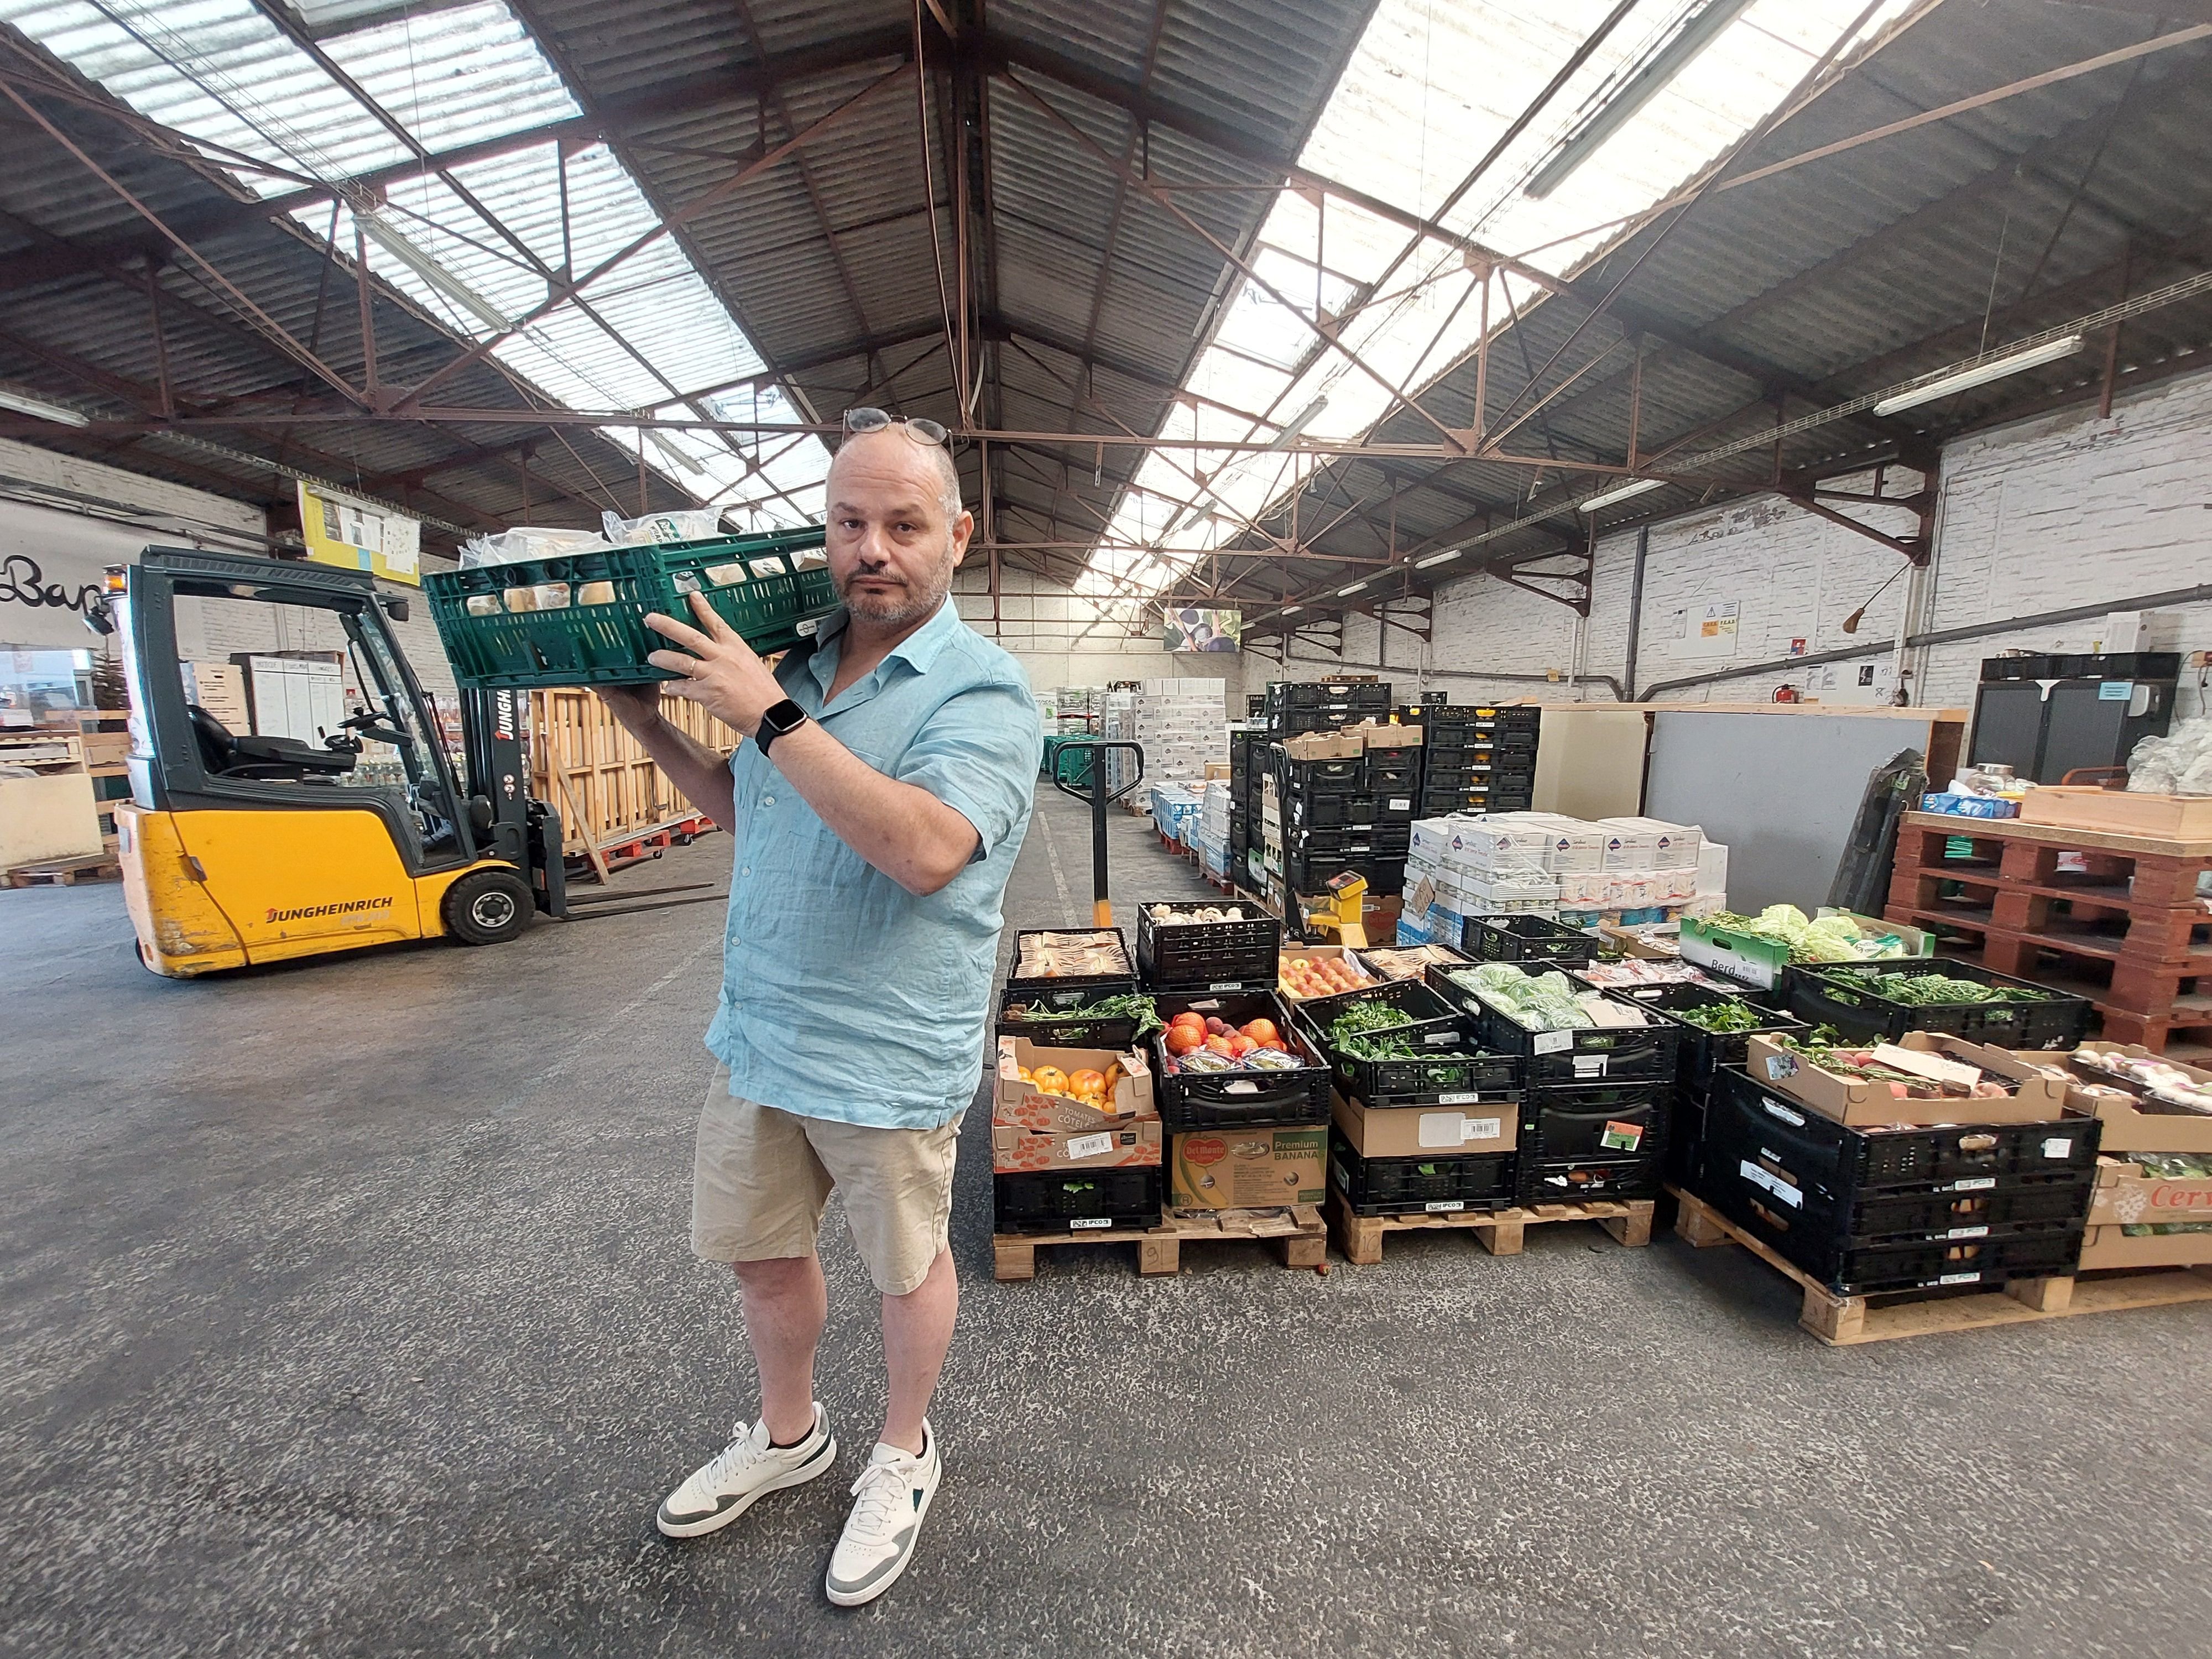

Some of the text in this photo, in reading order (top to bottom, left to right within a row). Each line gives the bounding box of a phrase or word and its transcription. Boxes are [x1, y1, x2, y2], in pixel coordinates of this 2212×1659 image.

[266, 896, 393, 924] JUNGHEINRICH
[1065, 1107, 1096, 1124] TOMATES
[1275, 1141, 1318, 1150] Premium
[1362, 1234, 1380, 1253] 10
[1147, 1246, 1159, 1266] 9
